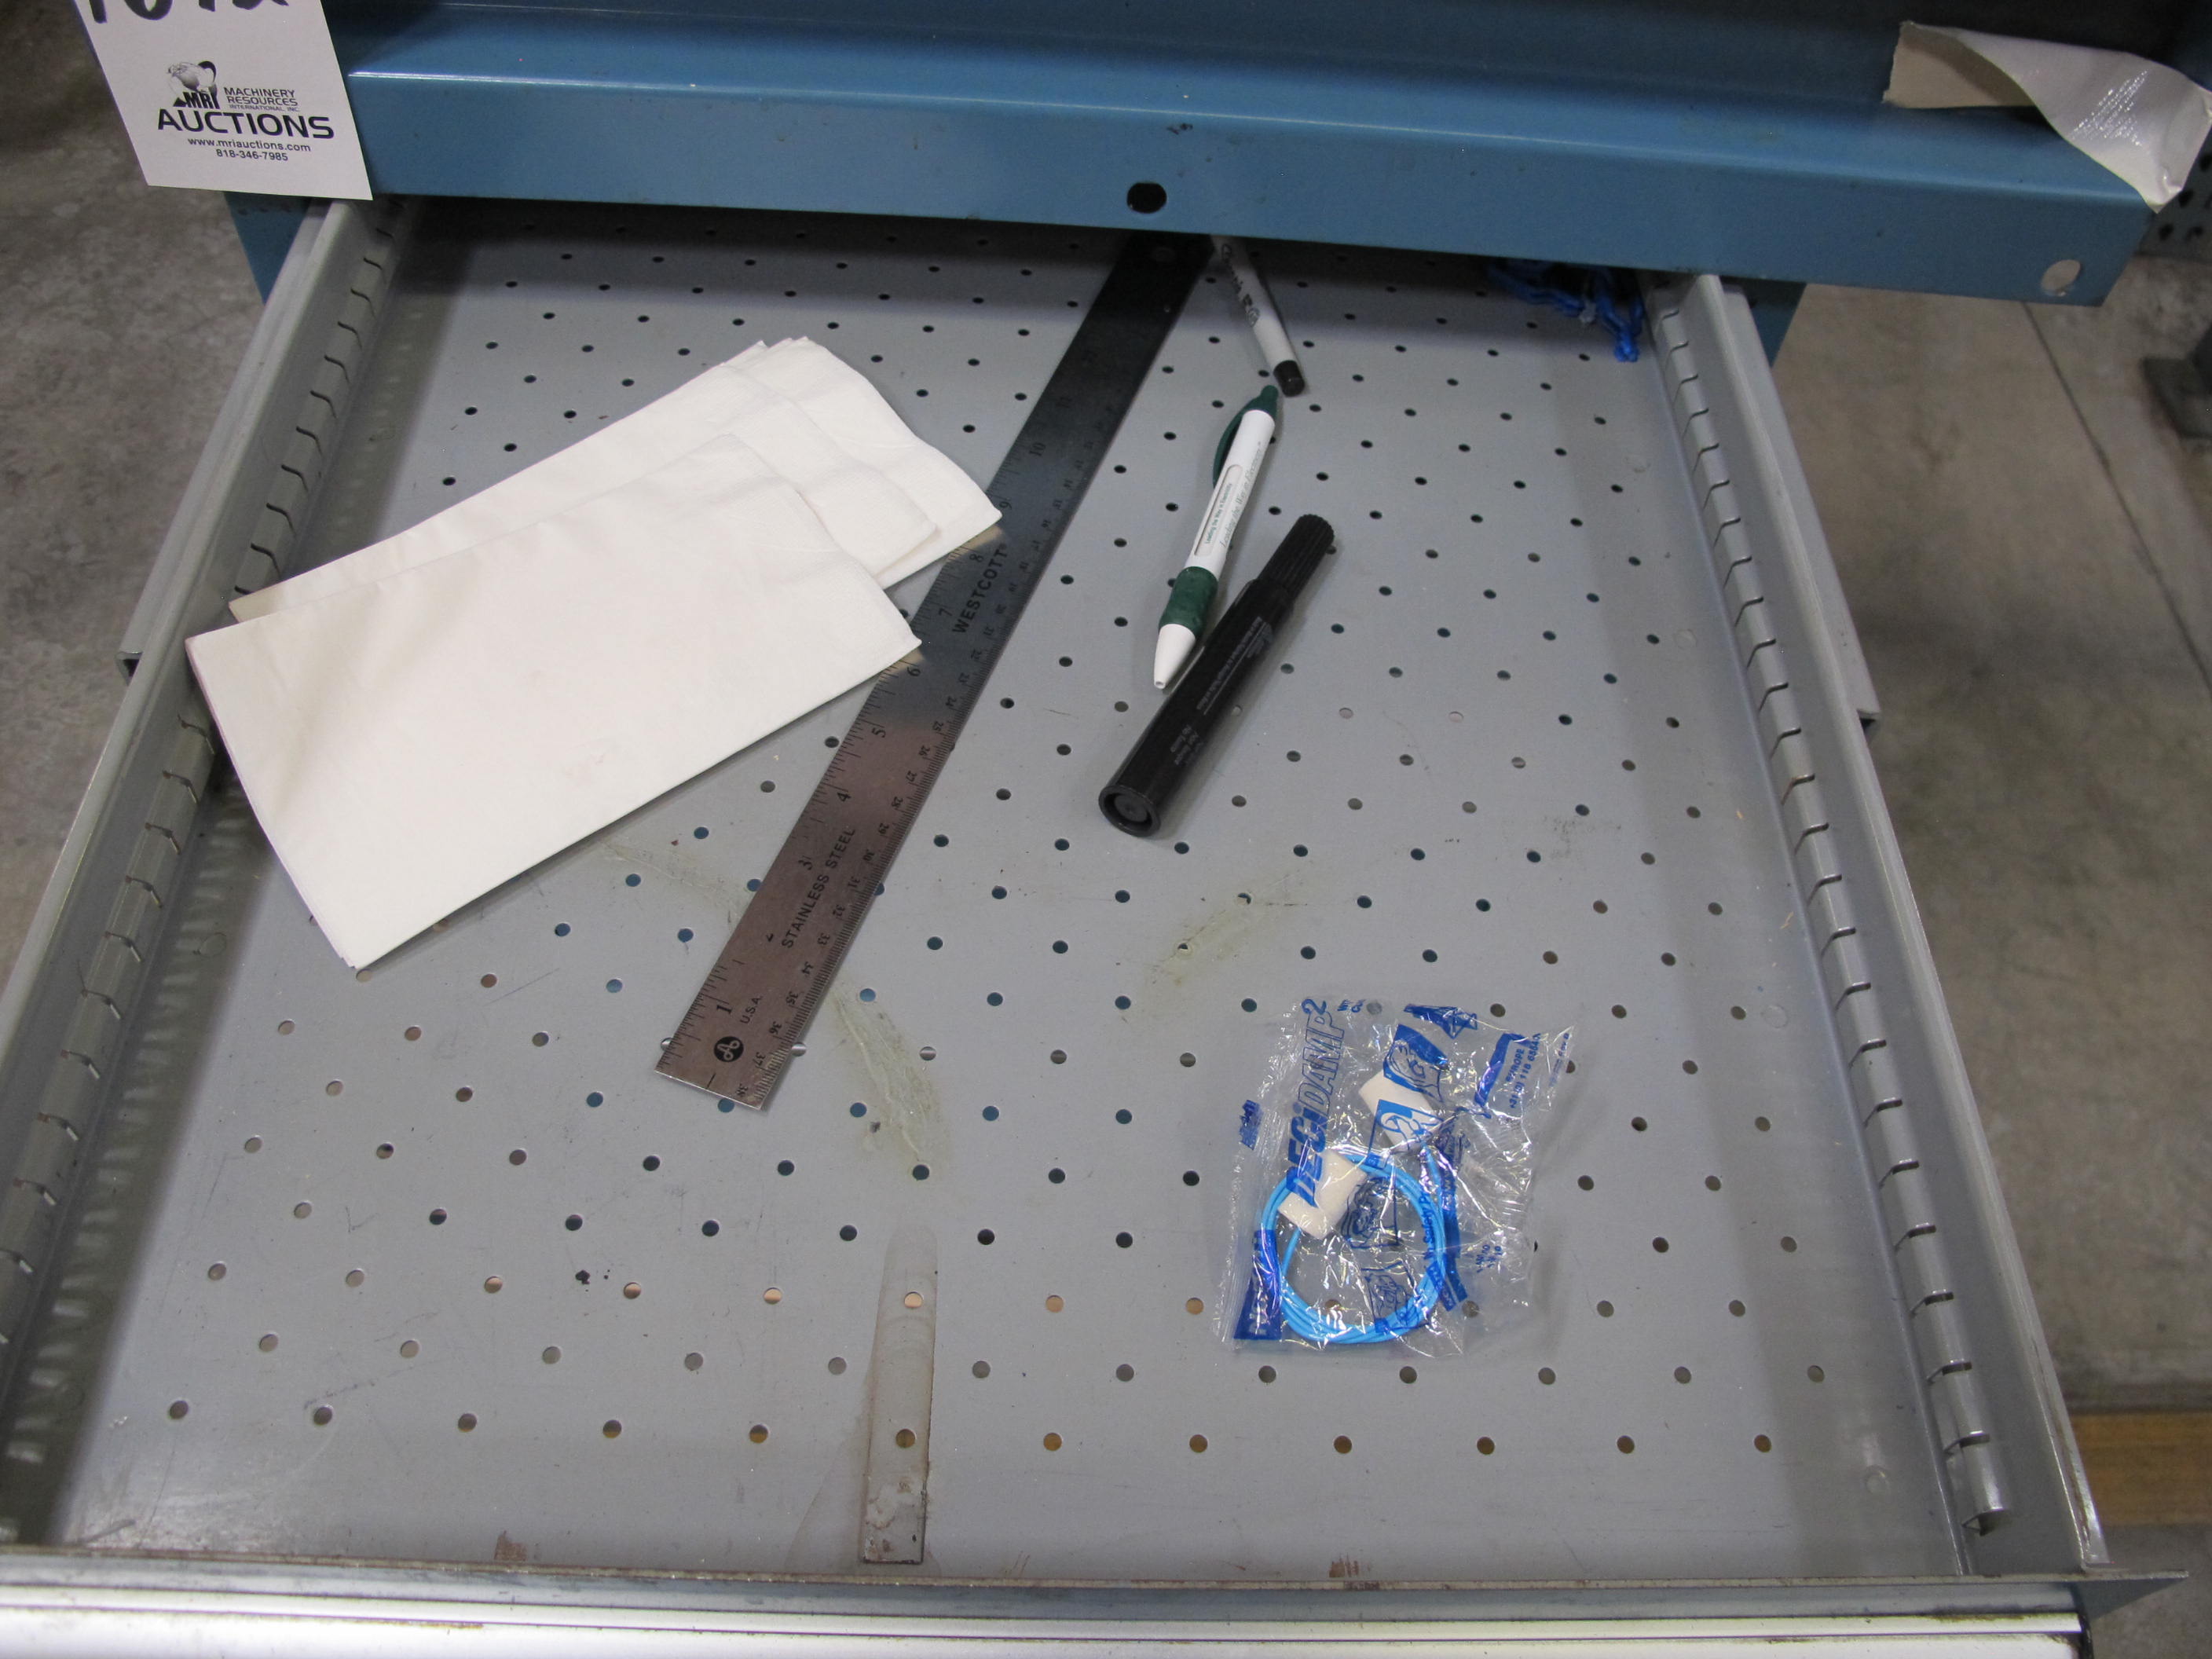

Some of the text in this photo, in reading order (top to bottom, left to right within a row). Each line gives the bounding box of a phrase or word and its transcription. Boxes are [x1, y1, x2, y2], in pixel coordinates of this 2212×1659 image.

[224, 87, 295, 97] MACHINERY
[182, 91, 220, 109] MRI
[226, 96, 298, 106] RESOURCES
[158, 108, 335, 139] AUCTIONS
[188, 138, 311, 152] www.mriauctions.com
[216, 148, 288, 161] 818-346-7985
[969, 553, 983, 562] 8
[938, 608, 953, 617] 7
[907, 667, 921, 676] 6
[945, 696, 957, 706] 24
[932, 720, 944, 731] 25
[872, 727, 886, 738] 5
[918, 745, 931, 756] 26
[906, 771, 917, 782] 27
[837, 792, 851, 802] 4
[891, 797, 903, 808] 28
[877, 823, 890, 834] 29
[781, 829, 855, 948] STAINLESS STEEL
[848, 877, 861, 889] 31
[832, 904, 845, 917] 32
[817, 932, 830, 946] 33
[786, 991, 799, 1005] 35
[716, 1005, 732, 1015] 1
[769, 1021, 782, 1035] 36
[753, 1052, 766, 1066] 37
[1505, 1049, 1525, 1082] EUROPE
[1423, 1206, 1435, 1243] Safety
